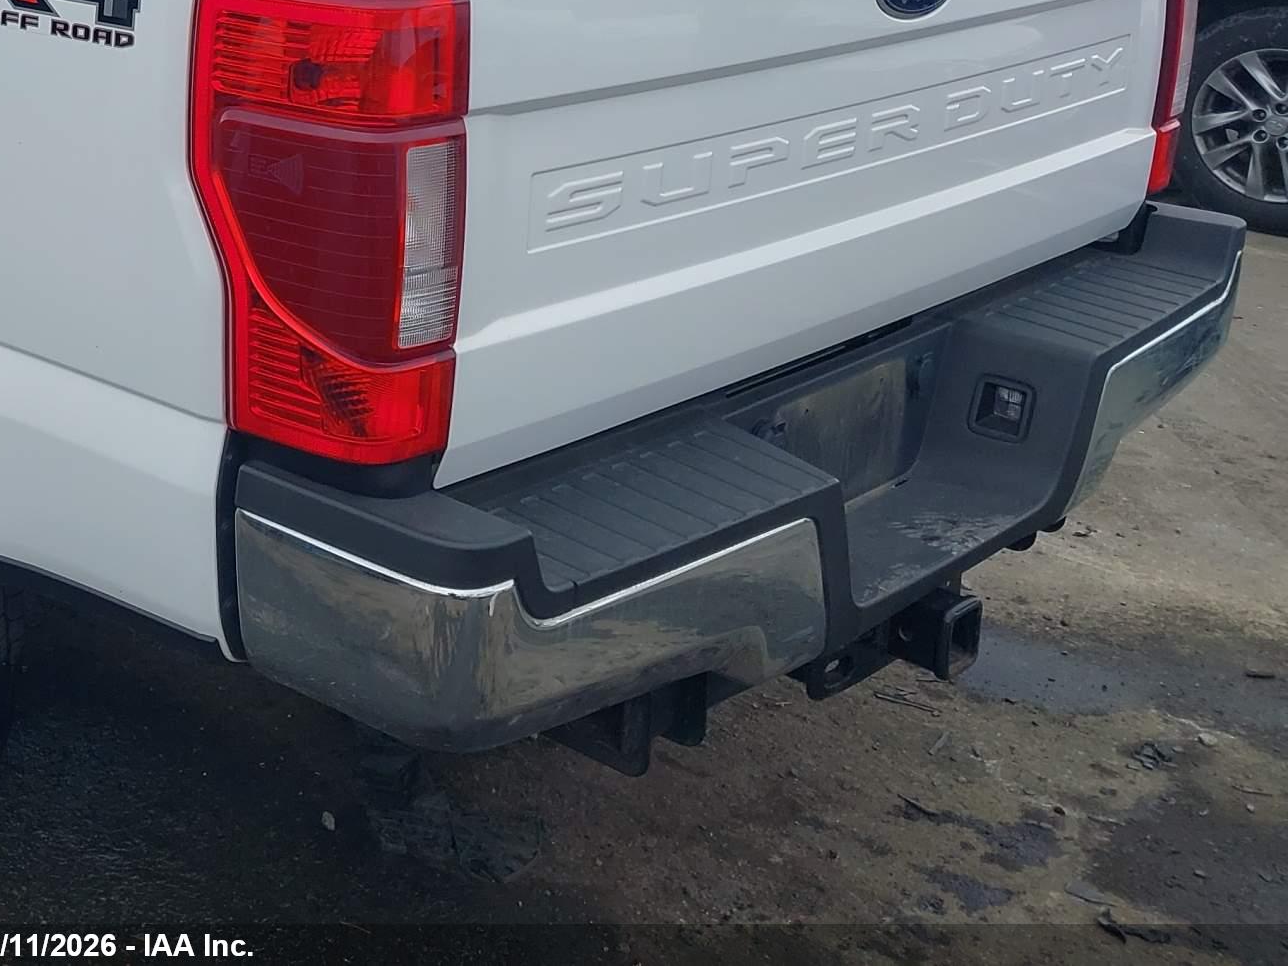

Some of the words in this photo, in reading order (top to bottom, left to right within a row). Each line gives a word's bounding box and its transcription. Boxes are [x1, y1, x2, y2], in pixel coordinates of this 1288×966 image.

[50, 18, 136, 48] ROAD
[545, 104, 921, 232] SUPER
[943, 46, 1124, 132] DUTY
